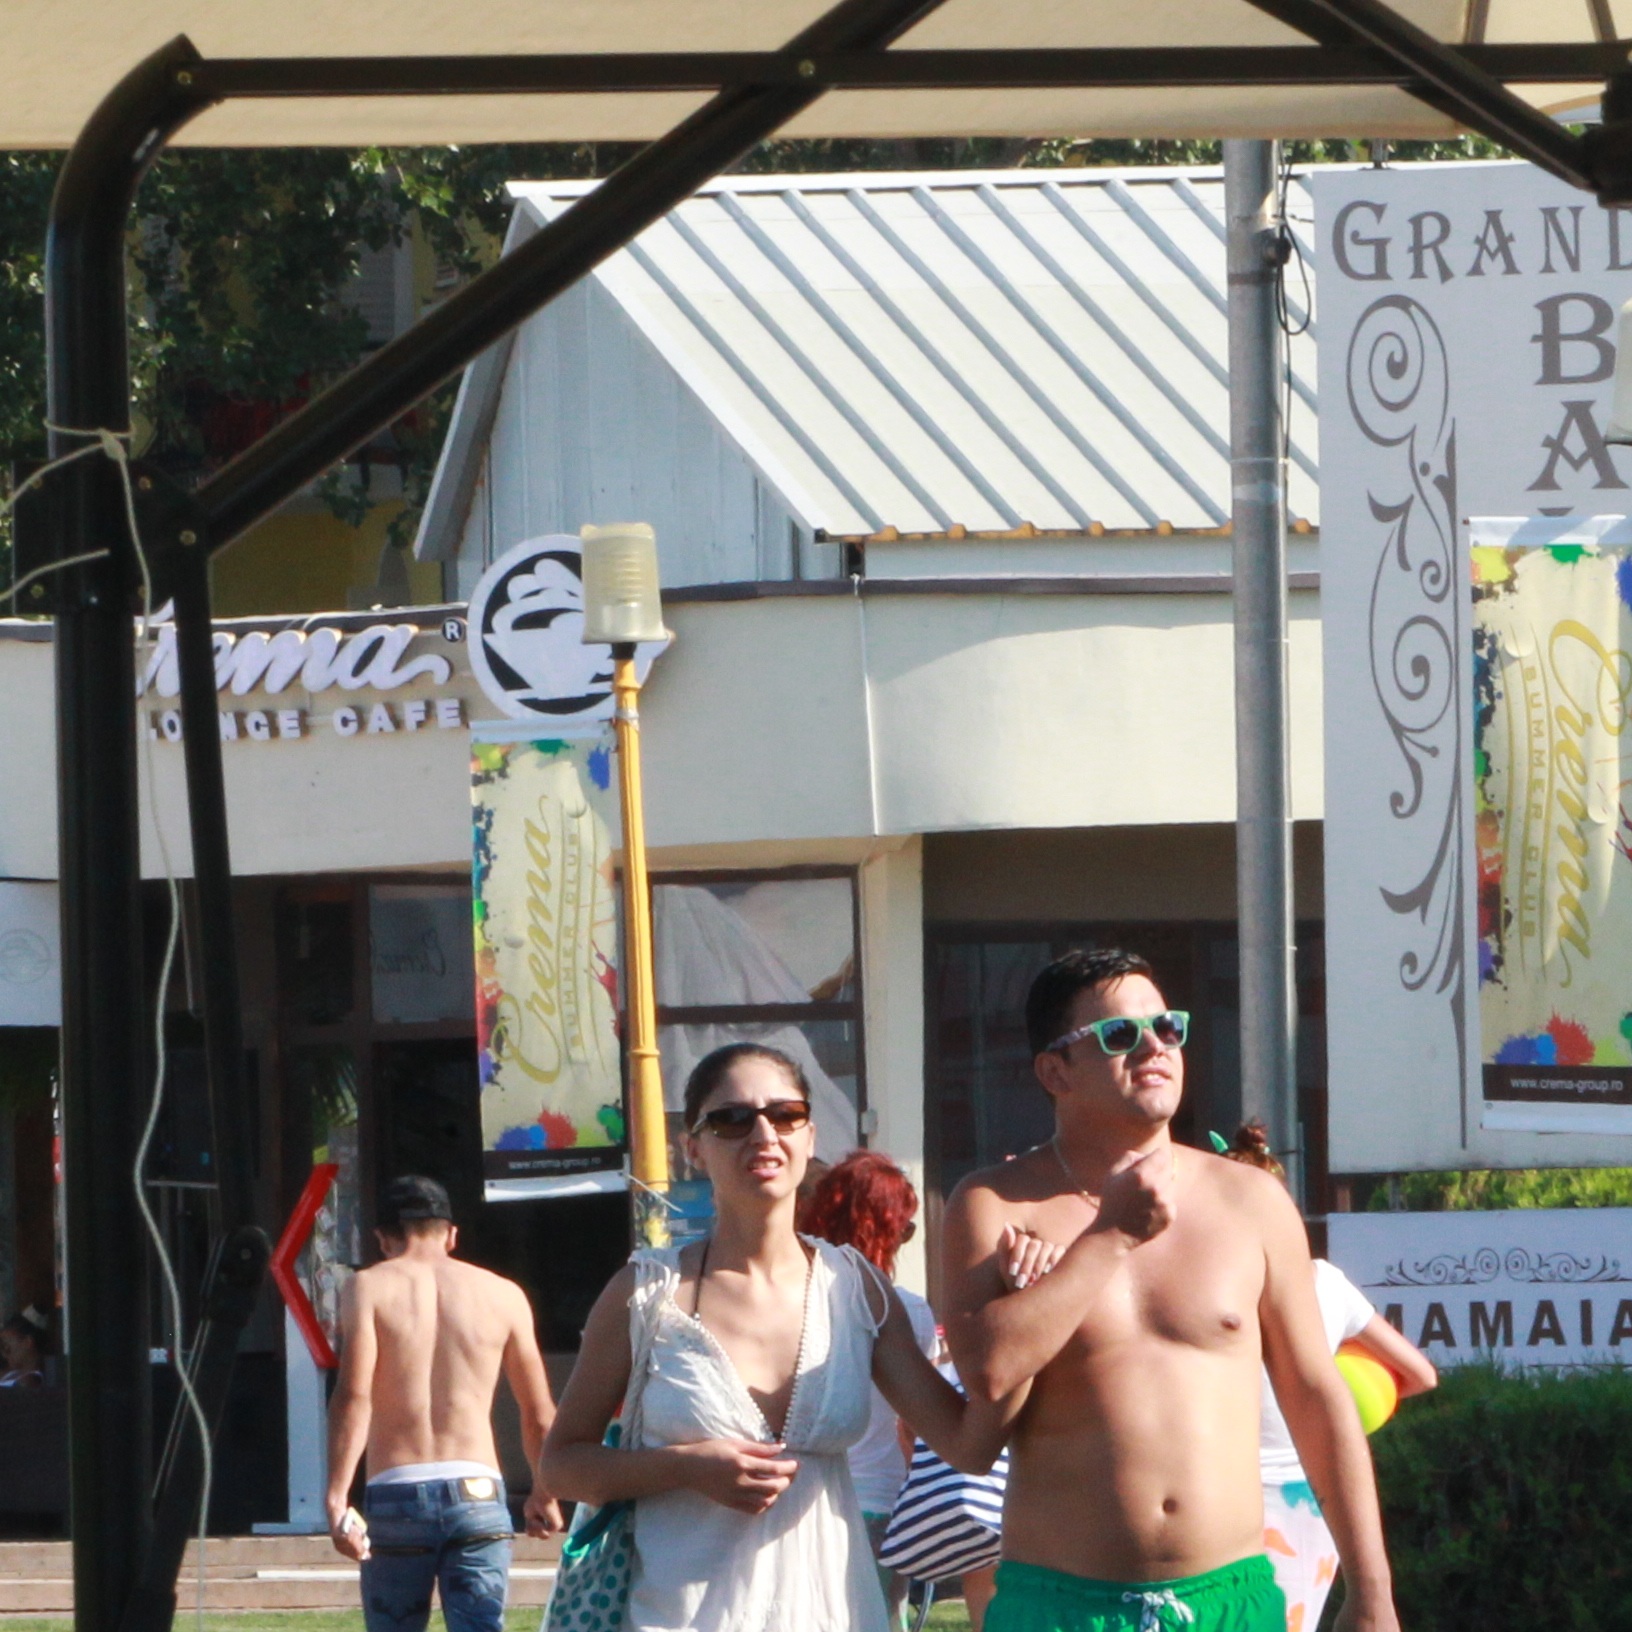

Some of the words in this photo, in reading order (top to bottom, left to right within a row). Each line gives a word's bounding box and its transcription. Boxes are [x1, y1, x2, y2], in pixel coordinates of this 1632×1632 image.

[1525, 292, 1630, 516] BA
[333, 699, 461, 737] CAFE
[491, 795, 562, 1084] Crema
